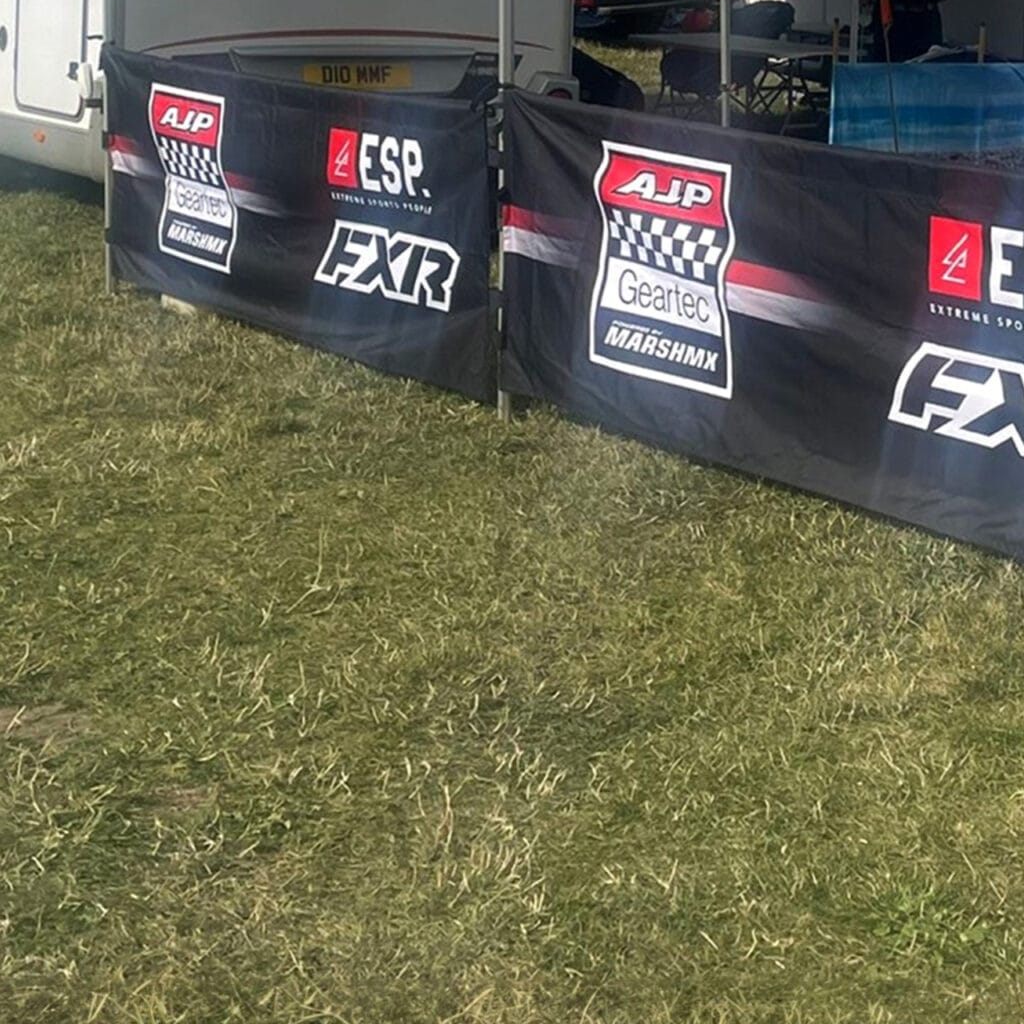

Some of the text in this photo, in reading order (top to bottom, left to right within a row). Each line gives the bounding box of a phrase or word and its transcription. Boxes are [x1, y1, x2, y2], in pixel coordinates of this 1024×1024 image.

[355, 65, 392, 84] MMF
[159, 106, 215, 134] AJP
[176, 181, 227, 218] Geartec
[615, 172, 713, 208] AJP
[167, 223, 228, 254] MARSHMX
[314, 219, 460, 312] FXR
[617, 269, 710, 324] Geartec
[929, 303, 990, 325] EXTREME
[603, 325, 719, 372] MARSHMX
